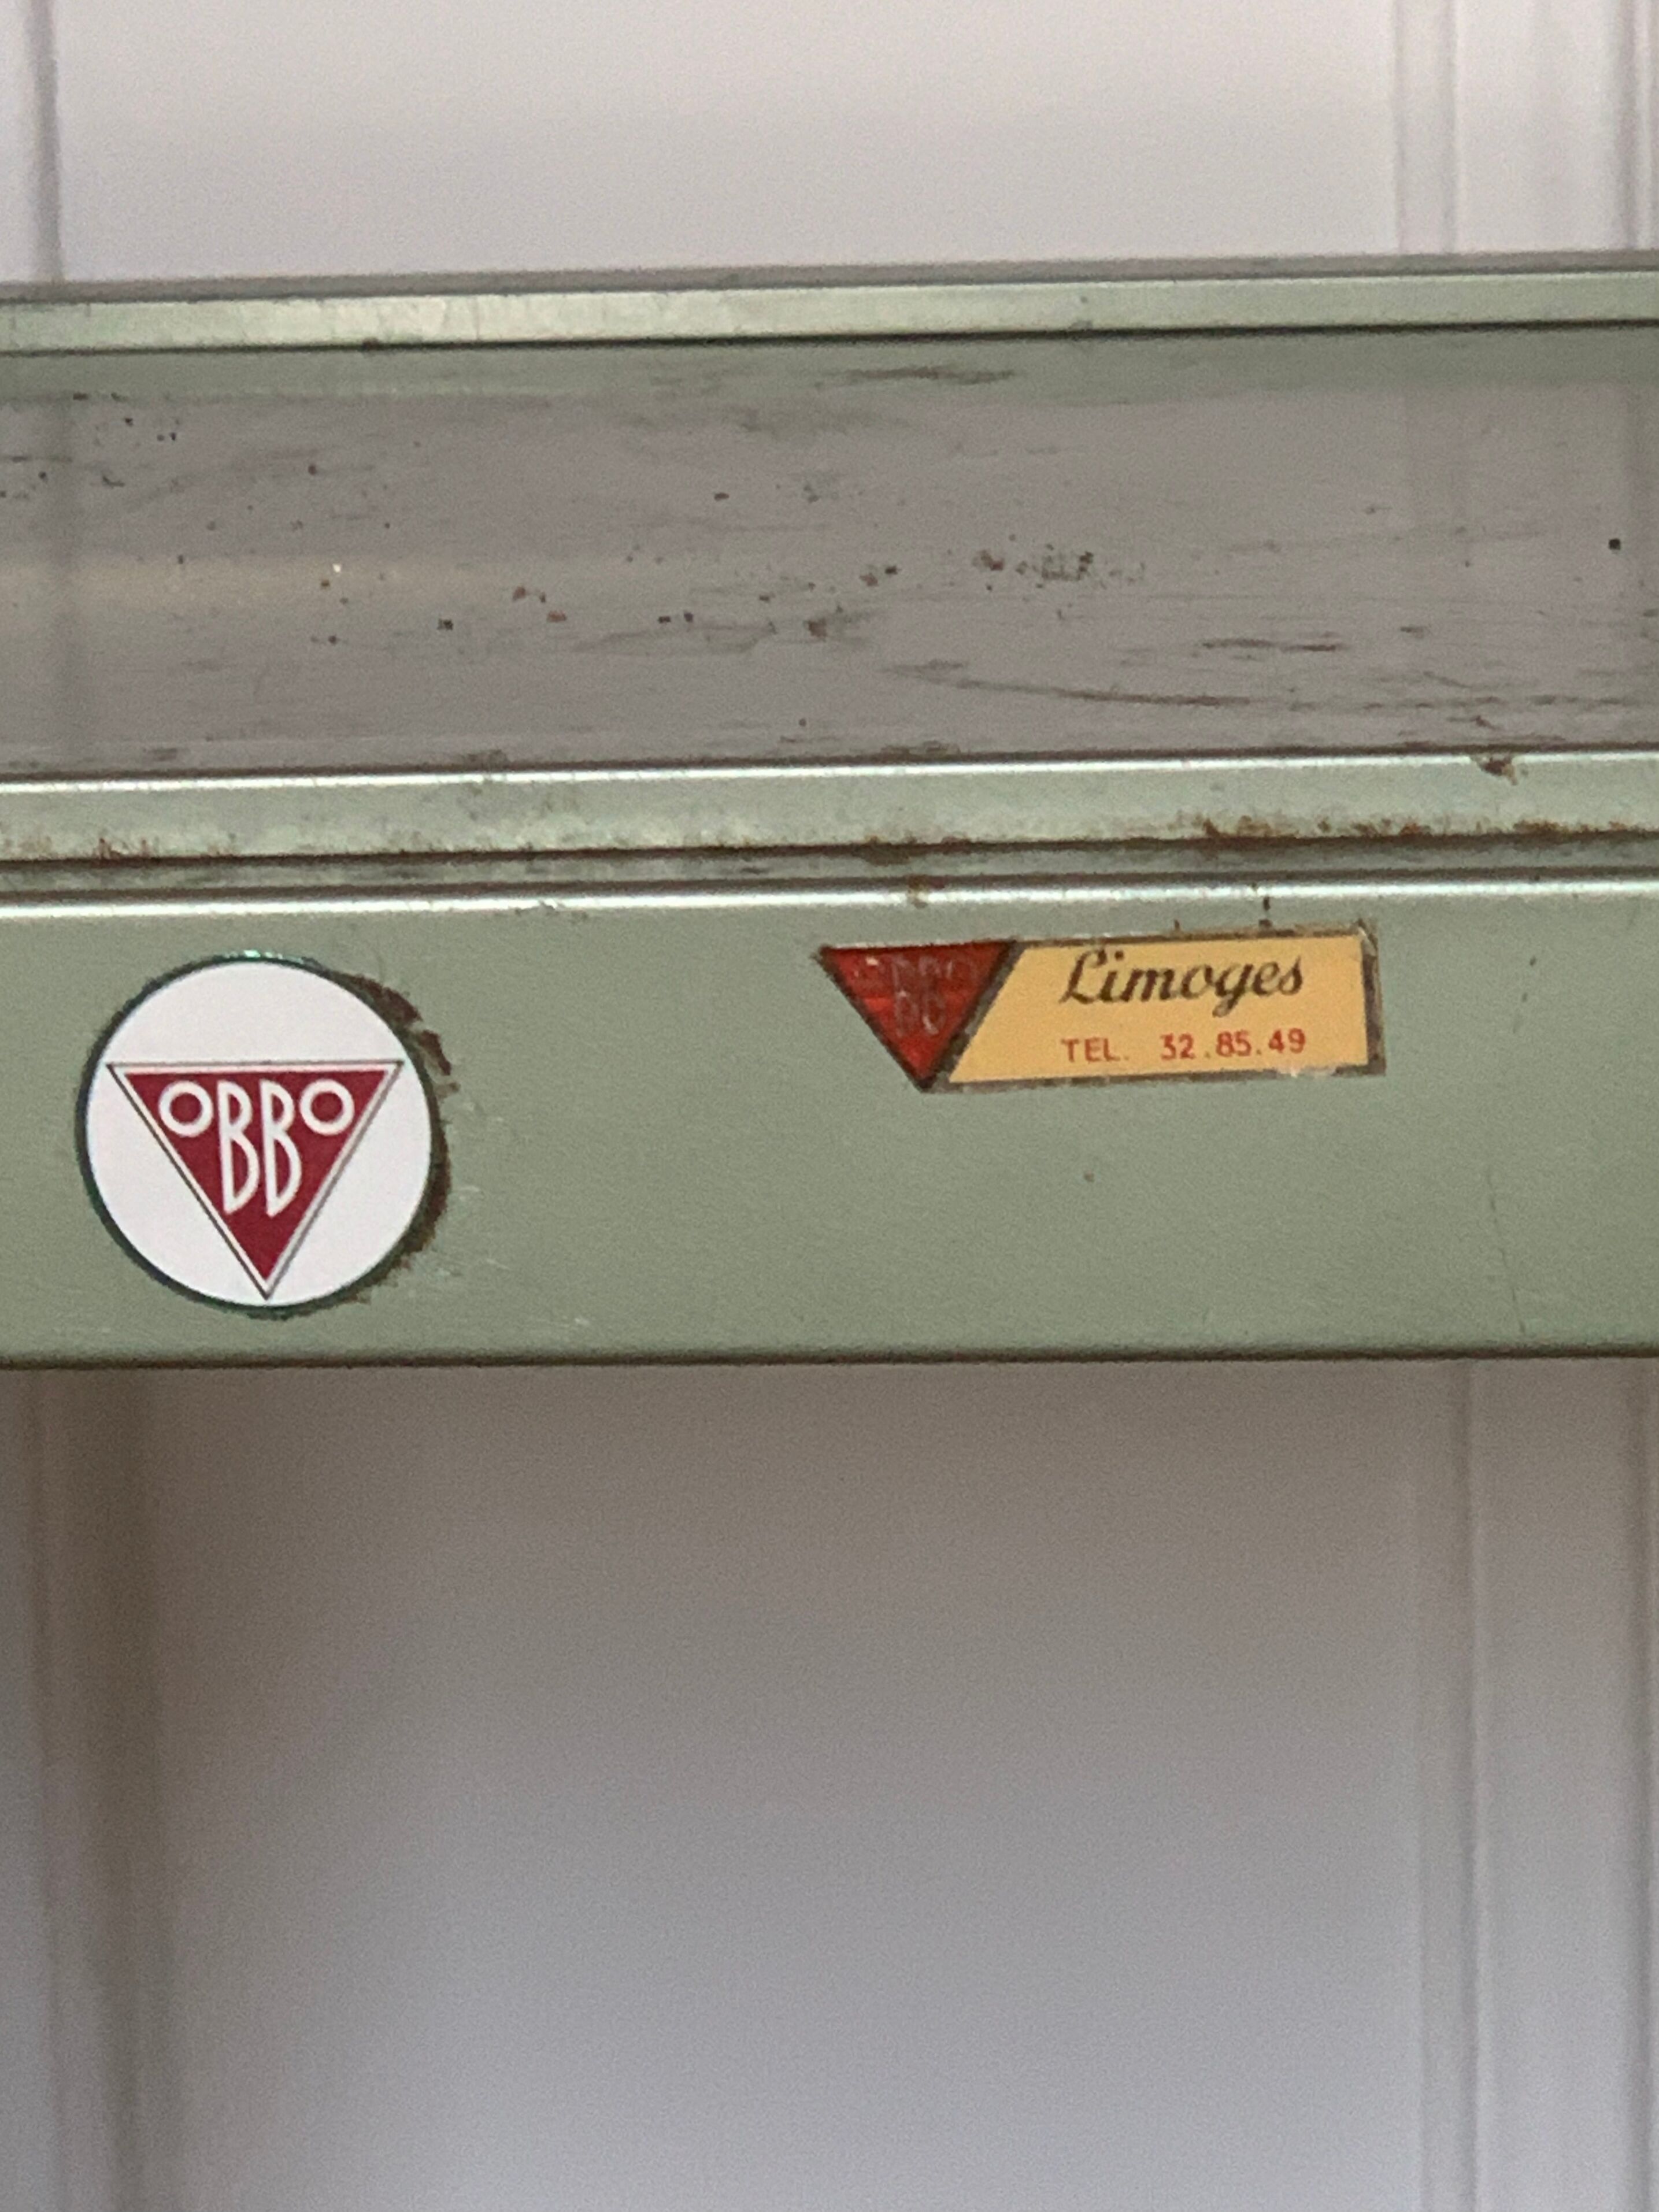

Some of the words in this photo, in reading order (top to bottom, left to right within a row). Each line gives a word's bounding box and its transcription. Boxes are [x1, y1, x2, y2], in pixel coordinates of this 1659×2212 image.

[1059, 948, 1304, 1018] Limoges
[1061, 1036, 1130, 1063] TEL.
[158, 1079, 355, 1218] OBBO
